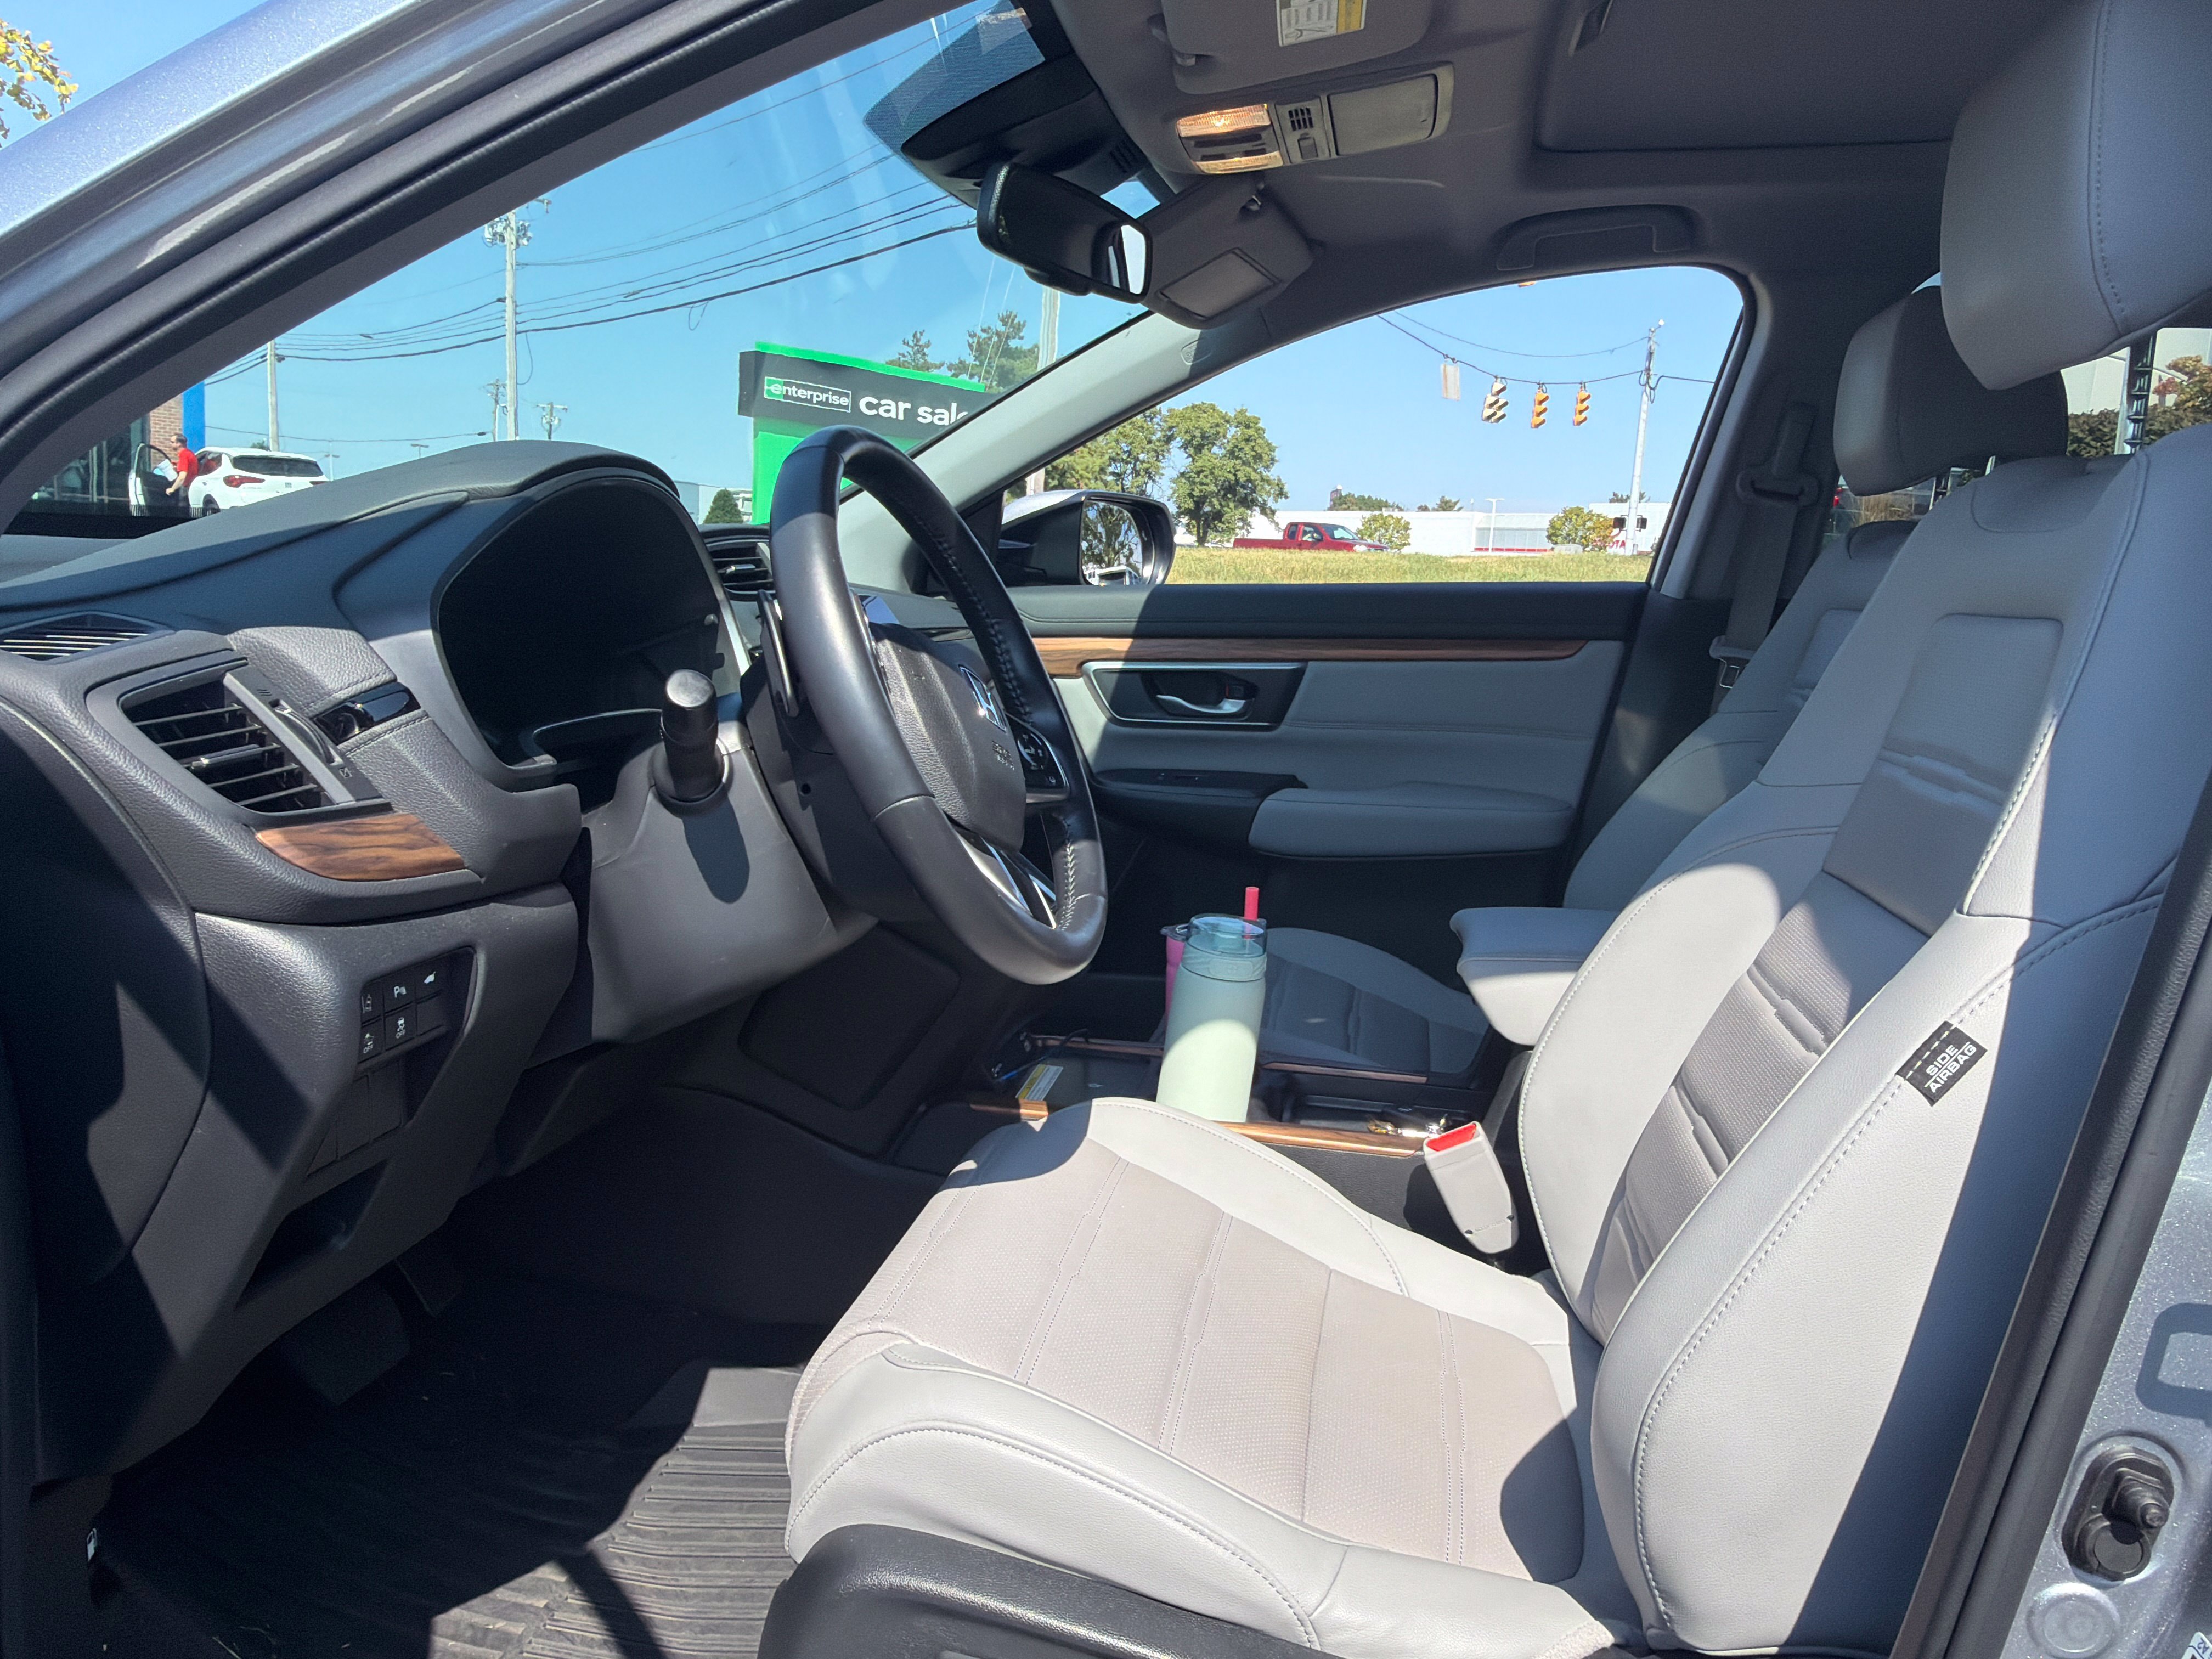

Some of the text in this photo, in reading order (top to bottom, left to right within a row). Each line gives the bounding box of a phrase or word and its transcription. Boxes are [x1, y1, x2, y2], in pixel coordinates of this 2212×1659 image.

[771, 383, 969, 426] enterprise car sal
[1926, 1045, 1959, 1076] SIDE
[1929, 1044, 1977, 1093] AIRBAG
